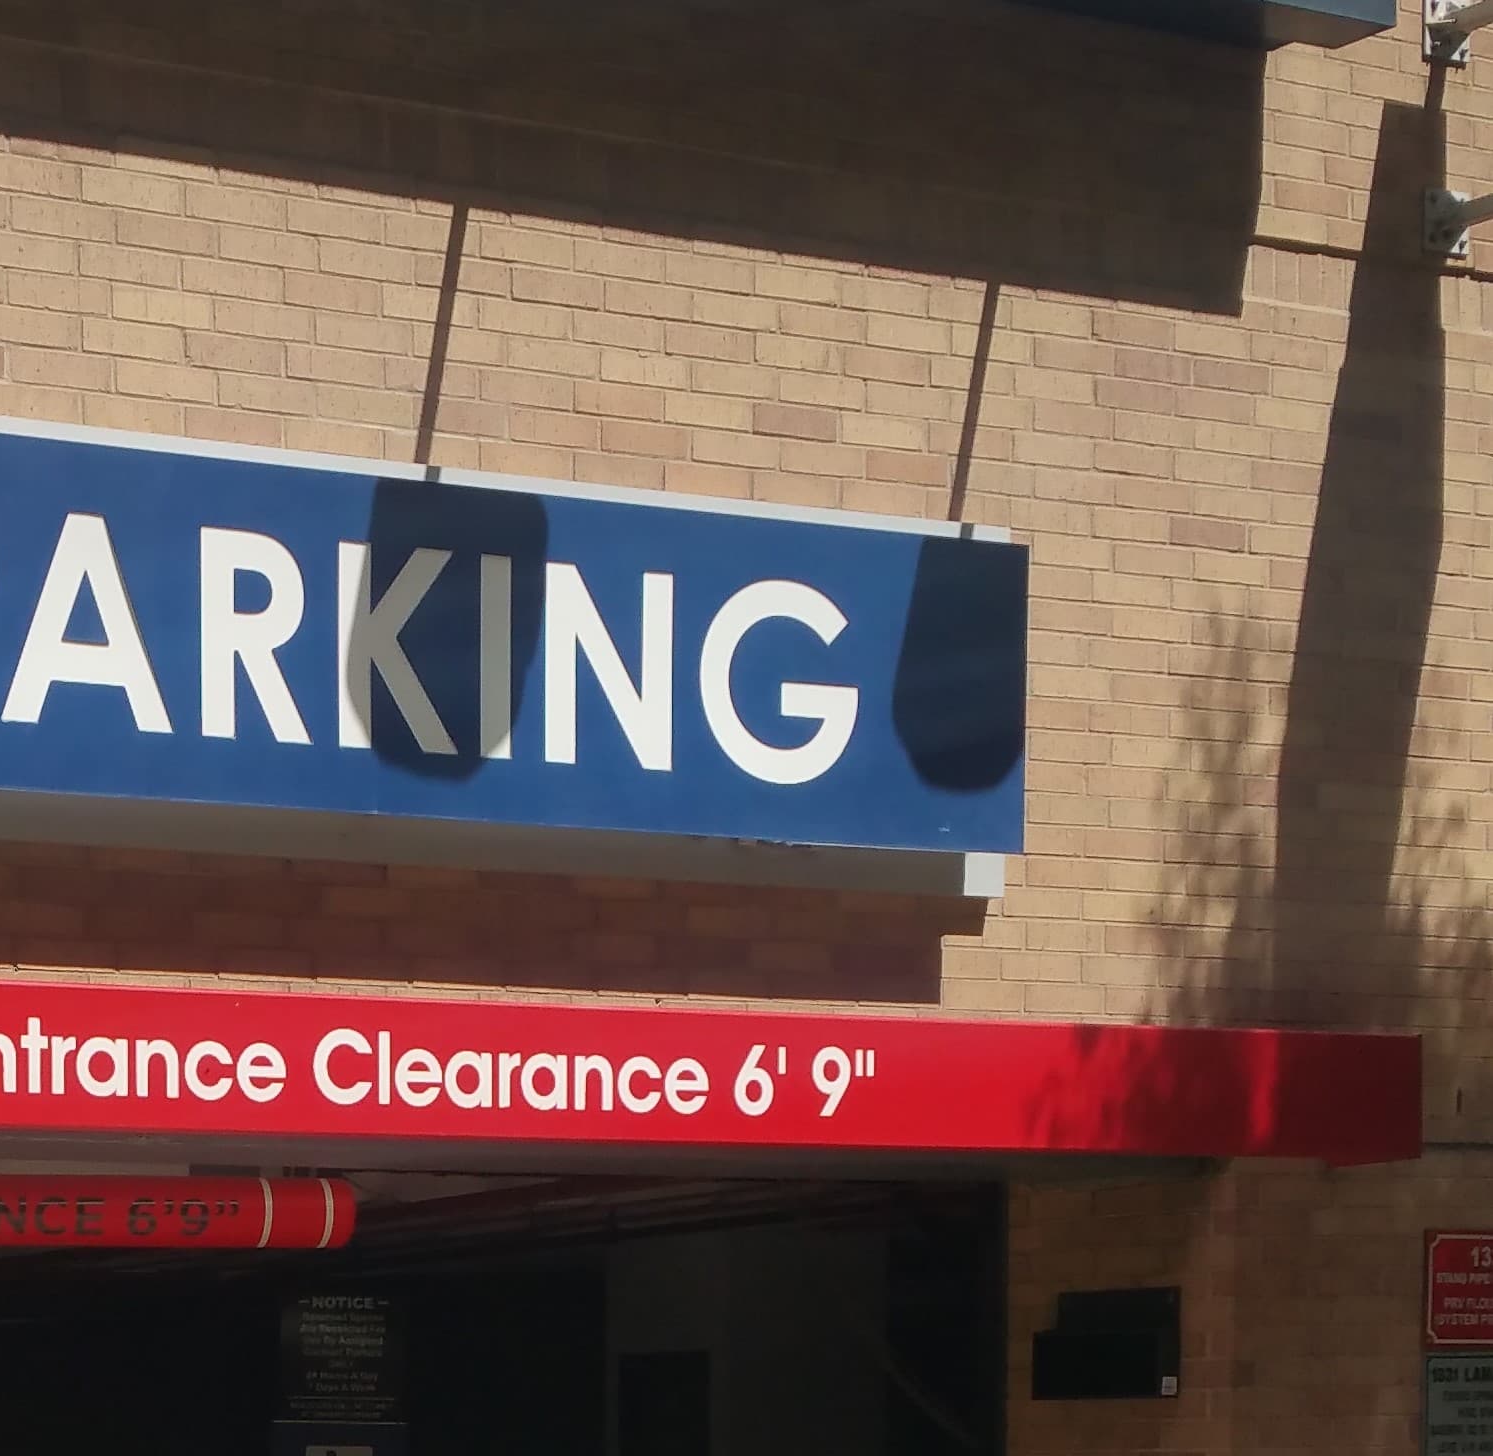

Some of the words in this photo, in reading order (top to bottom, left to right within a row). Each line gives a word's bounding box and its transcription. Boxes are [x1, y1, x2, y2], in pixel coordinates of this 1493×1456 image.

[312, 1027, 710, 1116] Clearance
[732, 1043, 786, 1117] 6'
[810, 1045, 876, 1118] 9"
[1470, 1246, 1493, 1267] 13
